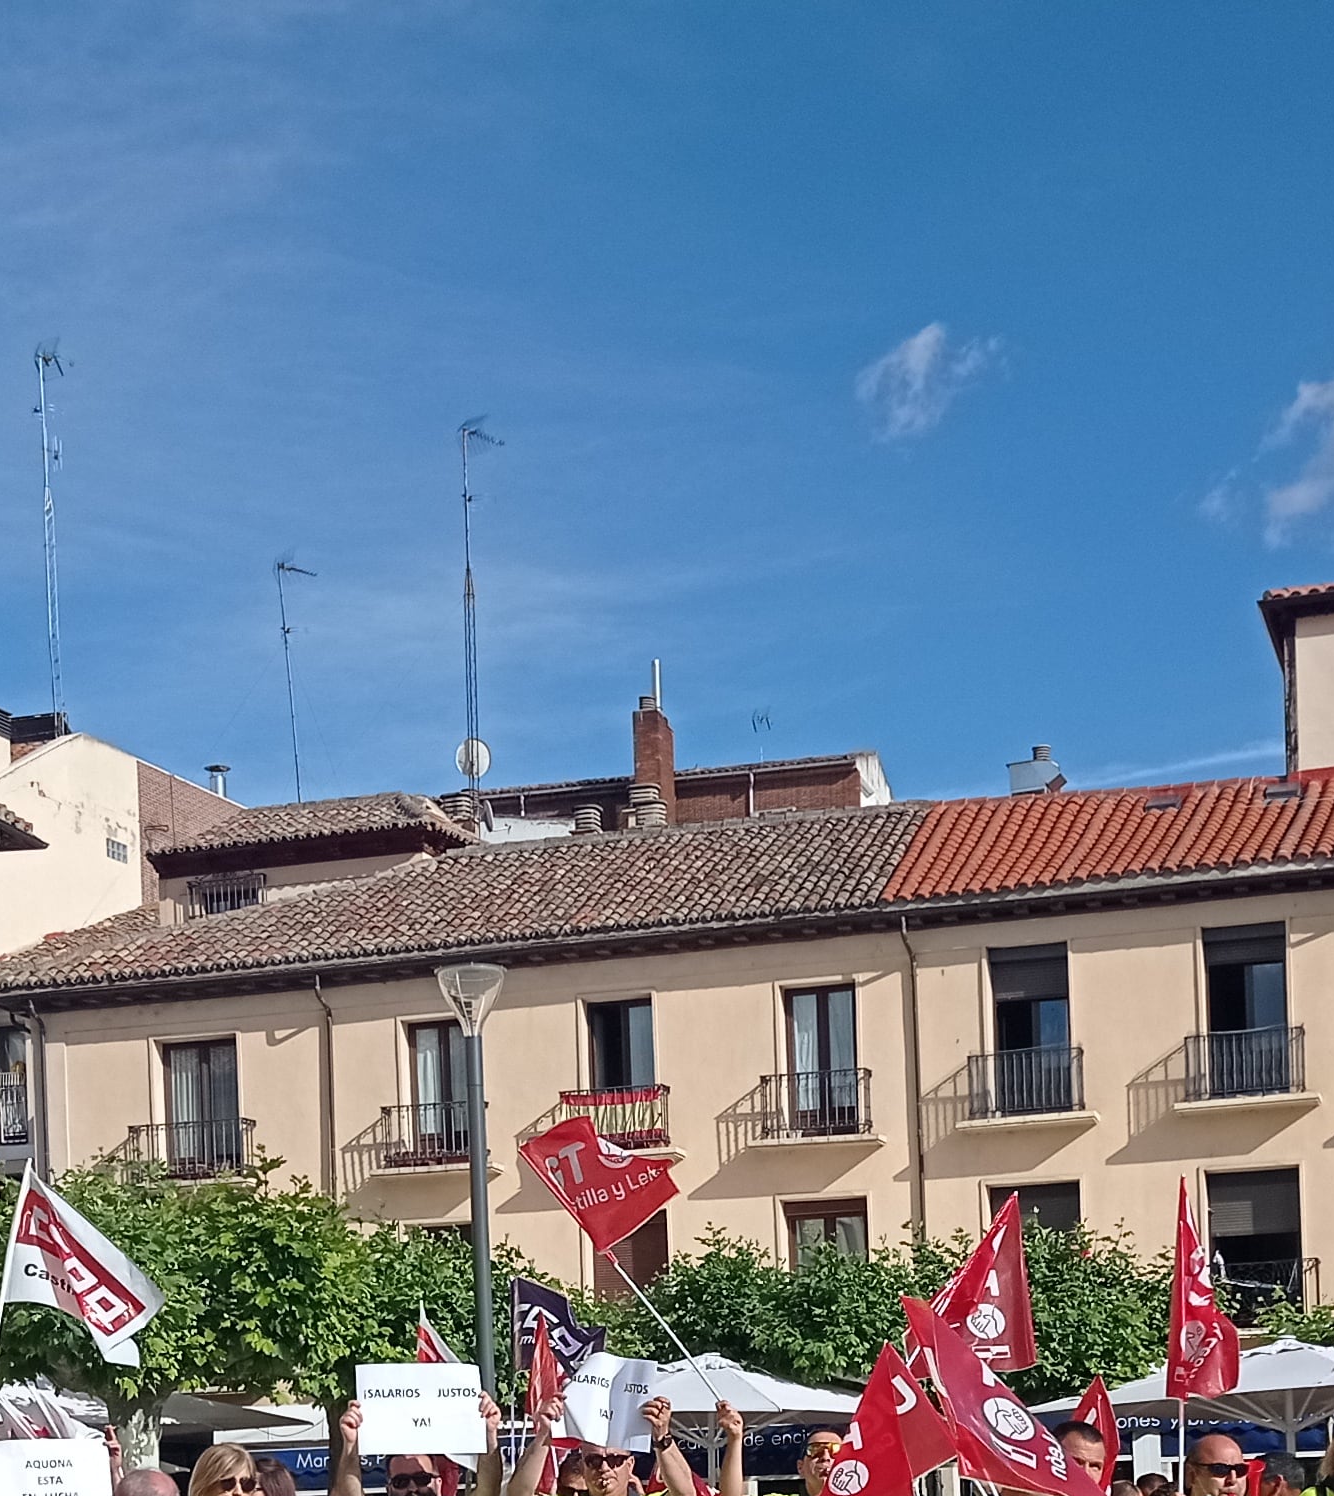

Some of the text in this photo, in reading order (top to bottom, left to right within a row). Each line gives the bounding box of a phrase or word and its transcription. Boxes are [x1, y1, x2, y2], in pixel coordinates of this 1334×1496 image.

[611, 1181, 626, 1201] y
[363, 1387, 477, 1399] ¡SALARIOS JUSTOS
[412, 1417, 431, 1428] YA!
[743, 1431, 765, 1447] de
[25, 1459, 73, 1469] AQUONA
[37, 1476, 63, 1485] ESTA
